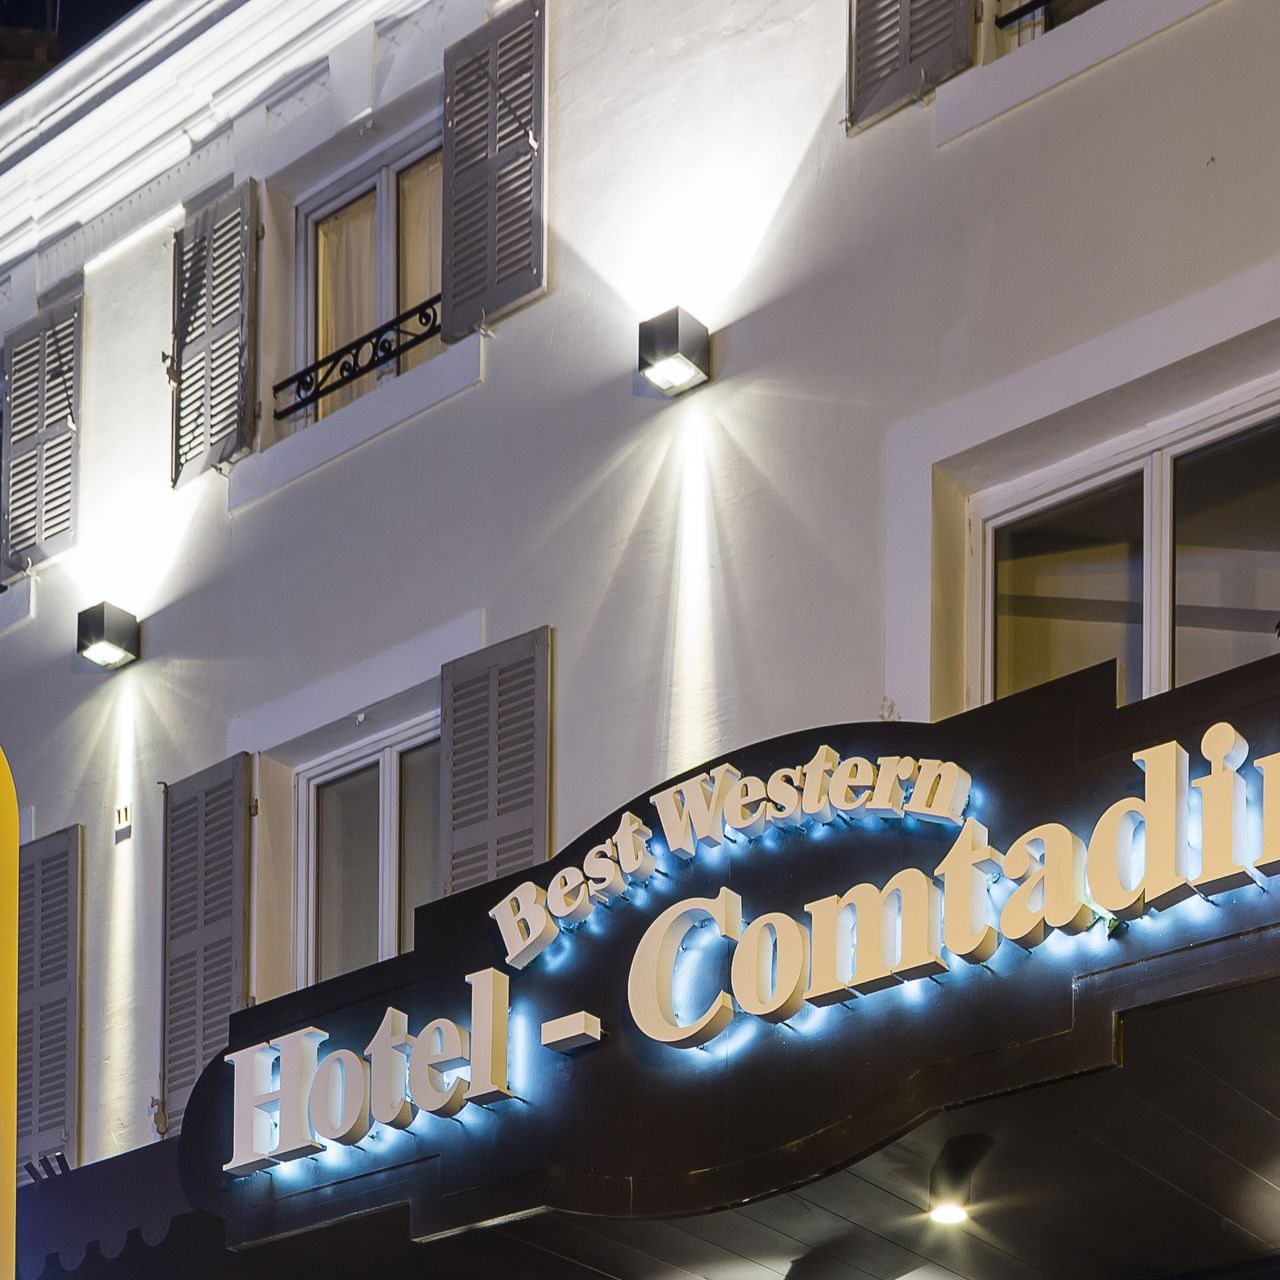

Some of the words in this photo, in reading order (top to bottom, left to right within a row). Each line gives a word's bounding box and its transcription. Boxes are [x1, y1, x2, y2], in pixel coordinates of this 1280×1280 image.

[488, 811, 657, 970] Best
[649, 744, 972, 860] Western
[222, 966, 510, 1177] Hotel
